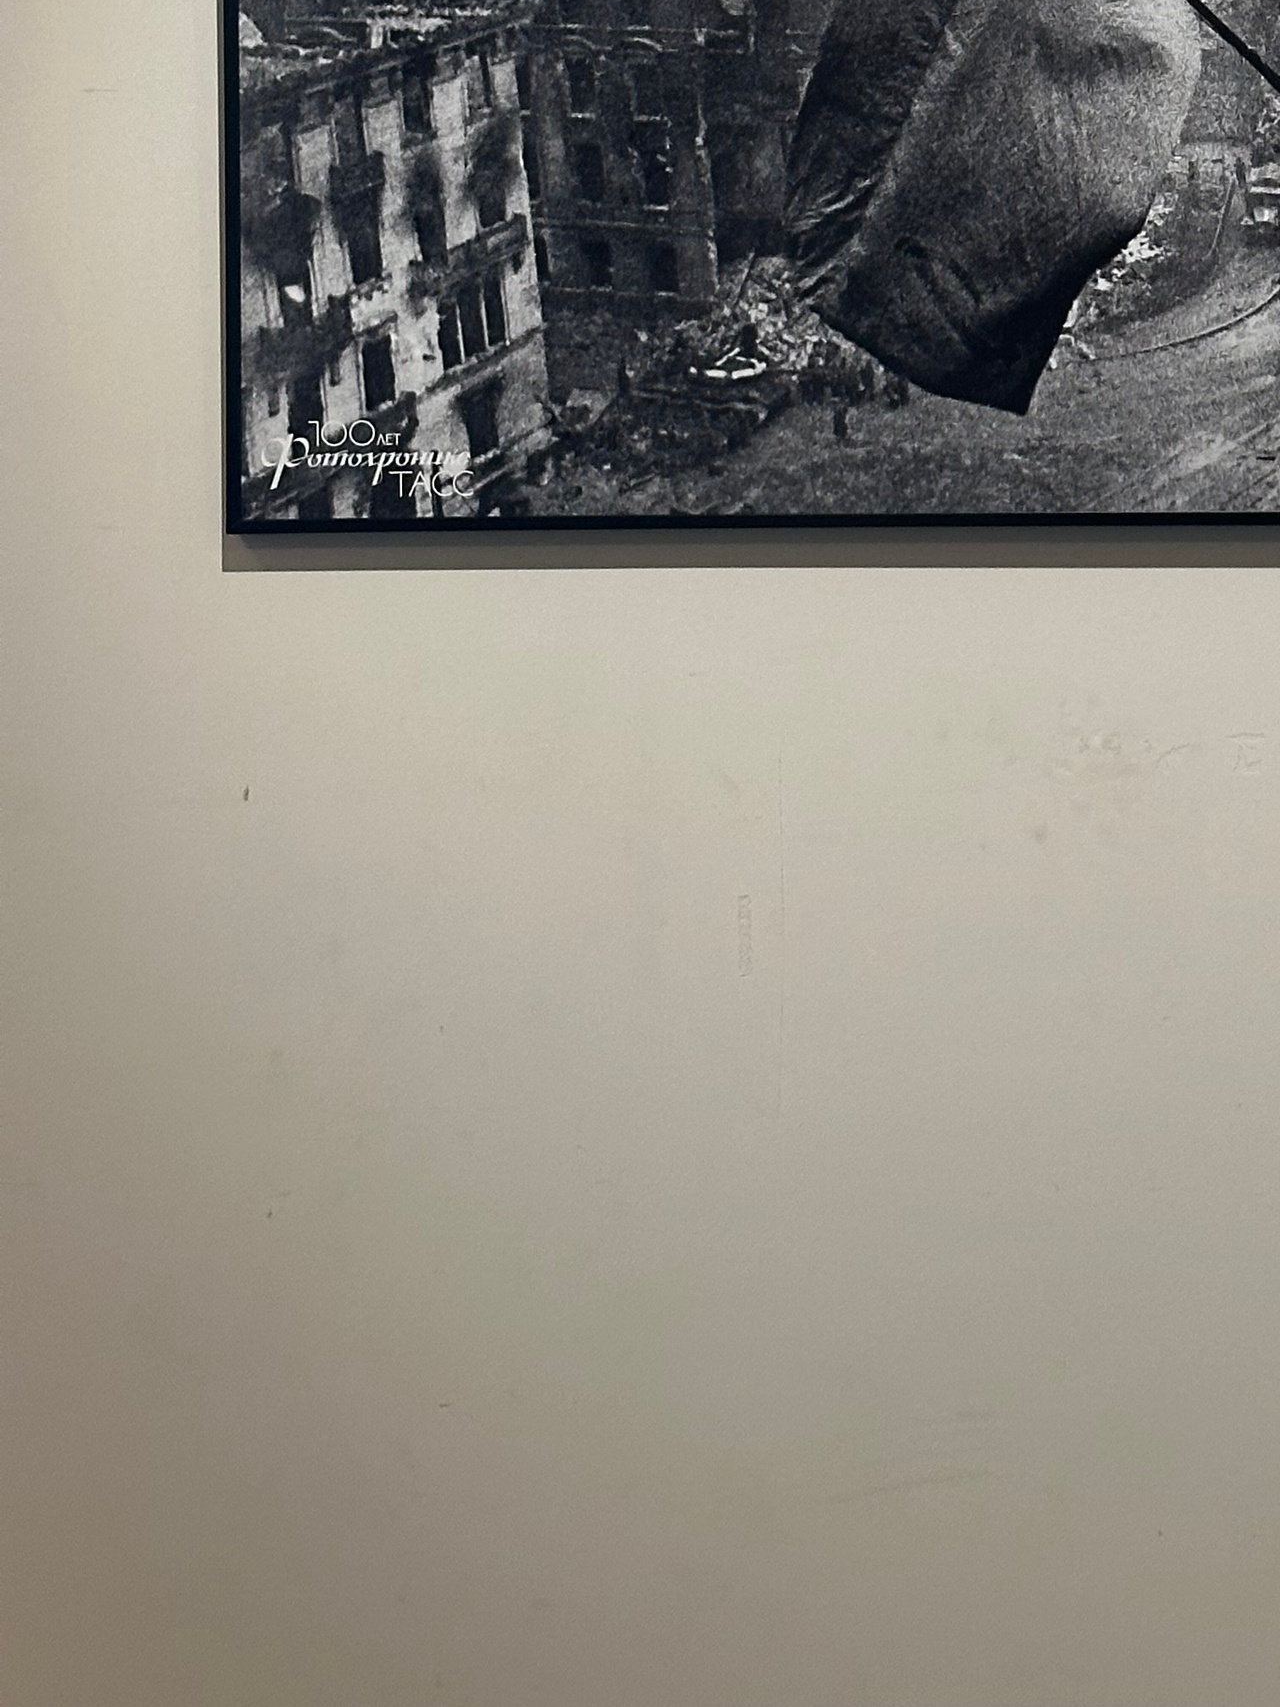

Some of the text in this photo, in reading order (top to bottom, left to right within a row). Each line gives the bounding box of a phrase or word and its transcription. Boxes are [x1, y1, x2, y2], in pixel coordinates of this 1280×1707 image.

[307, 419, 401, 447] 100 ЛЕТ
[388, 470, 475, 498] ТАСС
